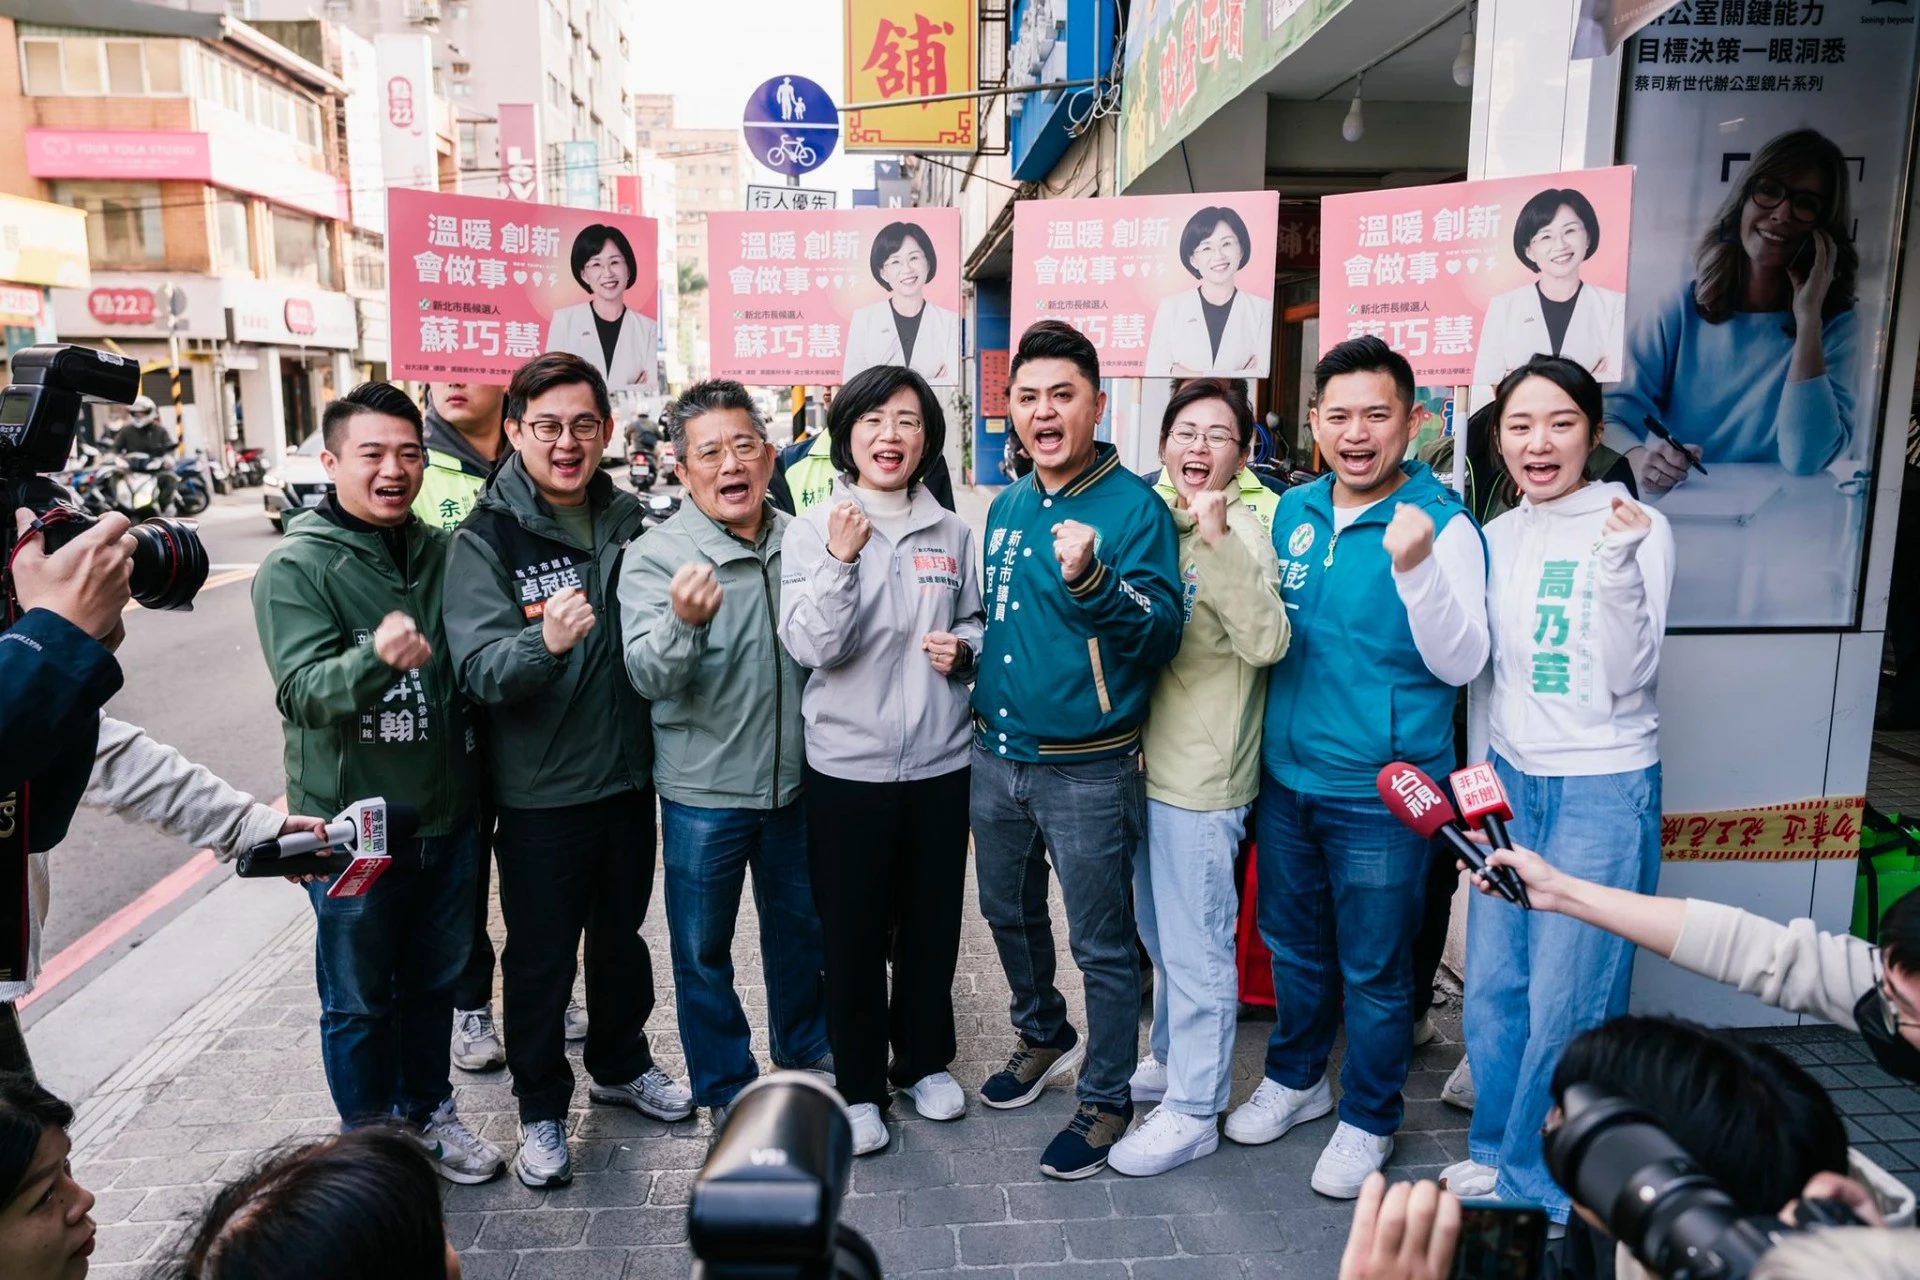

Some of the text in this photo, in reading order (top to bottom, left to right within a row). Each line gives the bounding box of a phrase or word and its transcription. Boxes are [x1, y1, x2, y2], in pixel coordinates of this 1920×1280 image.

[1860, 15, 1914, 26] Seeing beyond
[861, 13, 954, 111] 舖
[1638, 37, 1846, 65] 目標決策一眼洞悉
[1634, 75, 1823, 92] 蔡司新世代辦公型鏡片系列
[755, 191, 828, 209] 行人優先
[428, 213, 560, 258] 溫暖 創新
[1047, 217, 1170, 249] 溫暖 創新
[1358, 210, 1424, 248] 溫暖
[1432, 203, 1502, 242] 創新
[740, 230, 859, 260] 溫暖 創新
[413, 250, 508, 289] 會做事
[728, 265, 810, 296] 會做事
[1034, 255, 1117, 286] 會做事
[1344, 251, 1439, 288] 會做事
[433, 300, 500, 316] 新北市長候選人
[745, 310, 804, 320] 新北市長候選人
[1048, 299, 1108, 310] 新北市長候選人
[1360, 301, 1430, 315] 新北市長候選人
[419, 315, 541, 357] 蘇巧慧
[734, 324, 841, 358] 蘇巧慧
[1036, 313, 1145, 350] 巧慧
[515, 556, 572, 578] 新北市議員
[913, 555, 957, 574] 蘇巧慧
[985, 527, 1007, 631] 廖宜
[995, 530, 1023, 622] 新北市議員
[521, 568, 582, 601] 卓冠廷
[782, 577, 806, 585] TAIWAN
[1532, 559, 1579, 695] 高乃芸
[409, 668, 428, 741] 市議員參選人
[1391, 769, 1442, 818] 台視
[1458, 770, 1490, 790] 非凡
[1464, 785, 1498, 808] 新聞
[372, 808, 386, 853] 壹新聞
[1662, 811, 1861, 849] 勿靠近 施工危險
[1678, 850, 1700, 859] 安全
